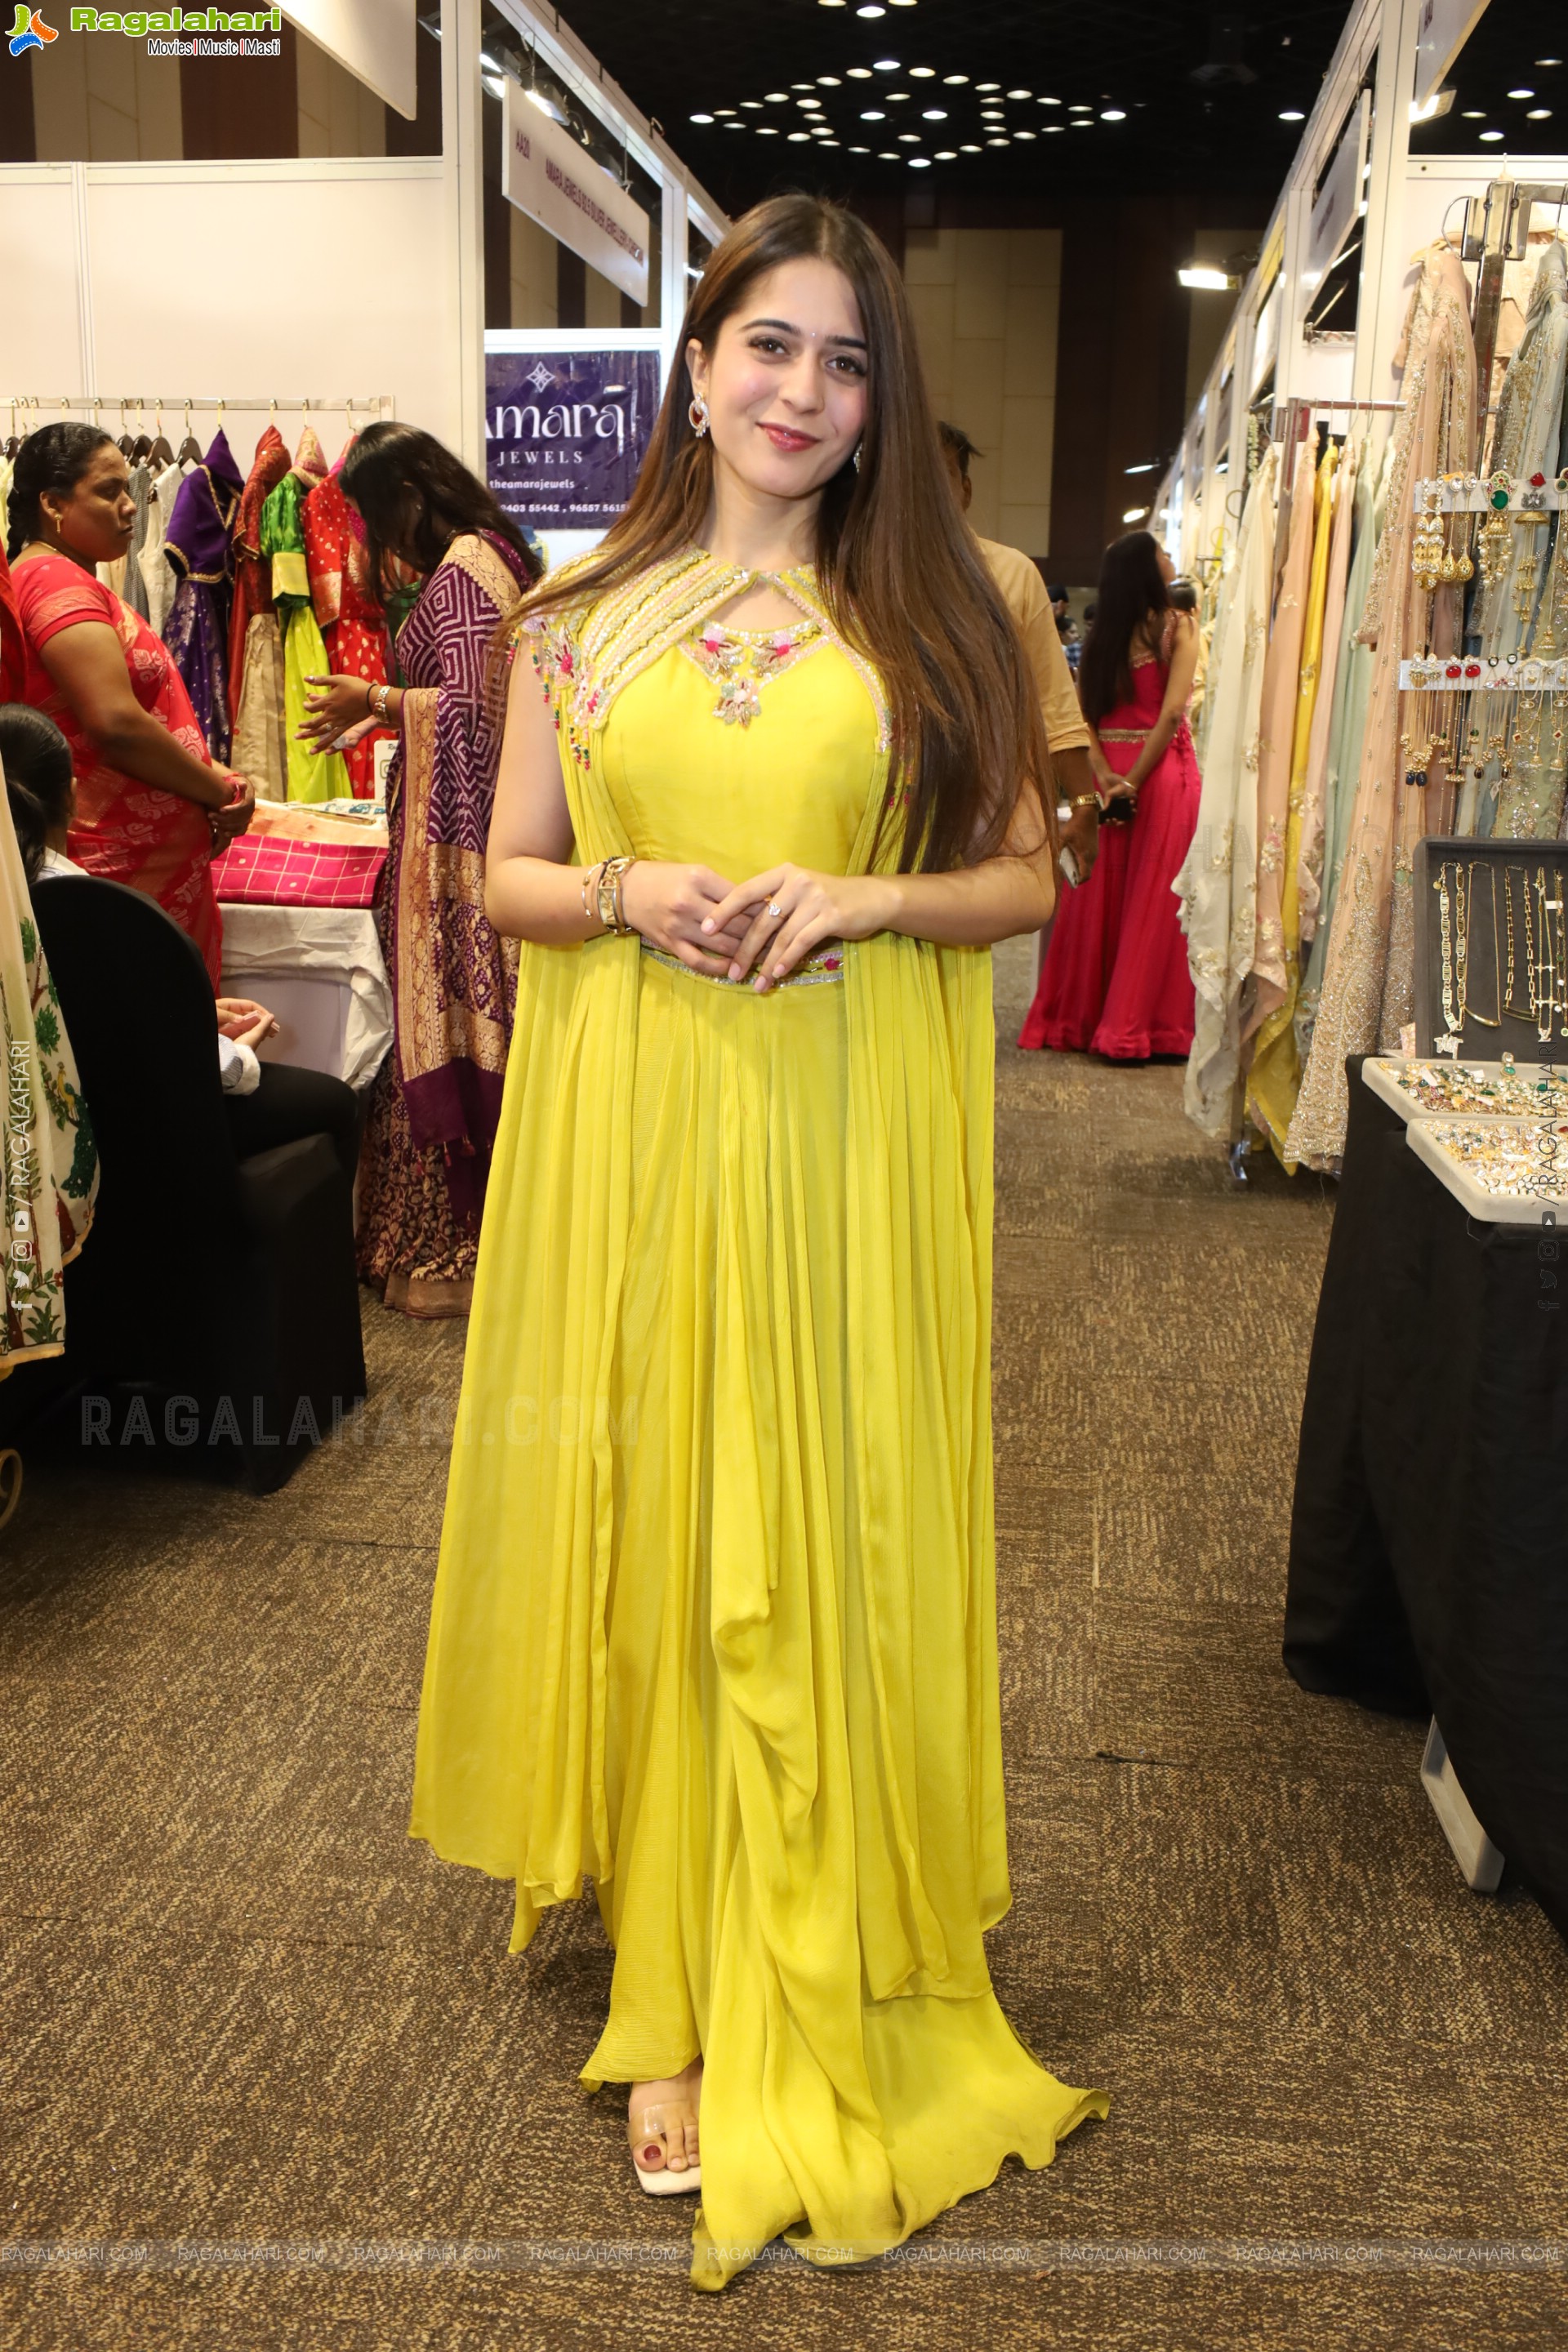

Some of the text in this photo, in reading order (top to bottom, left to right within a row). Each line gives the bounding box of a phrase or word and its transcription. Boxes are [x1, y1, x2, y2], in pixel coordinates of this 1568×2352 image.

[497, 450, 583, 466] JEWELS
[489, 479, 575, 491] theamarajewels
[528, 504, 560, 513] 55442
[569, 504, 599, 513] 96557
[603, 503, 630, 512] 5615
